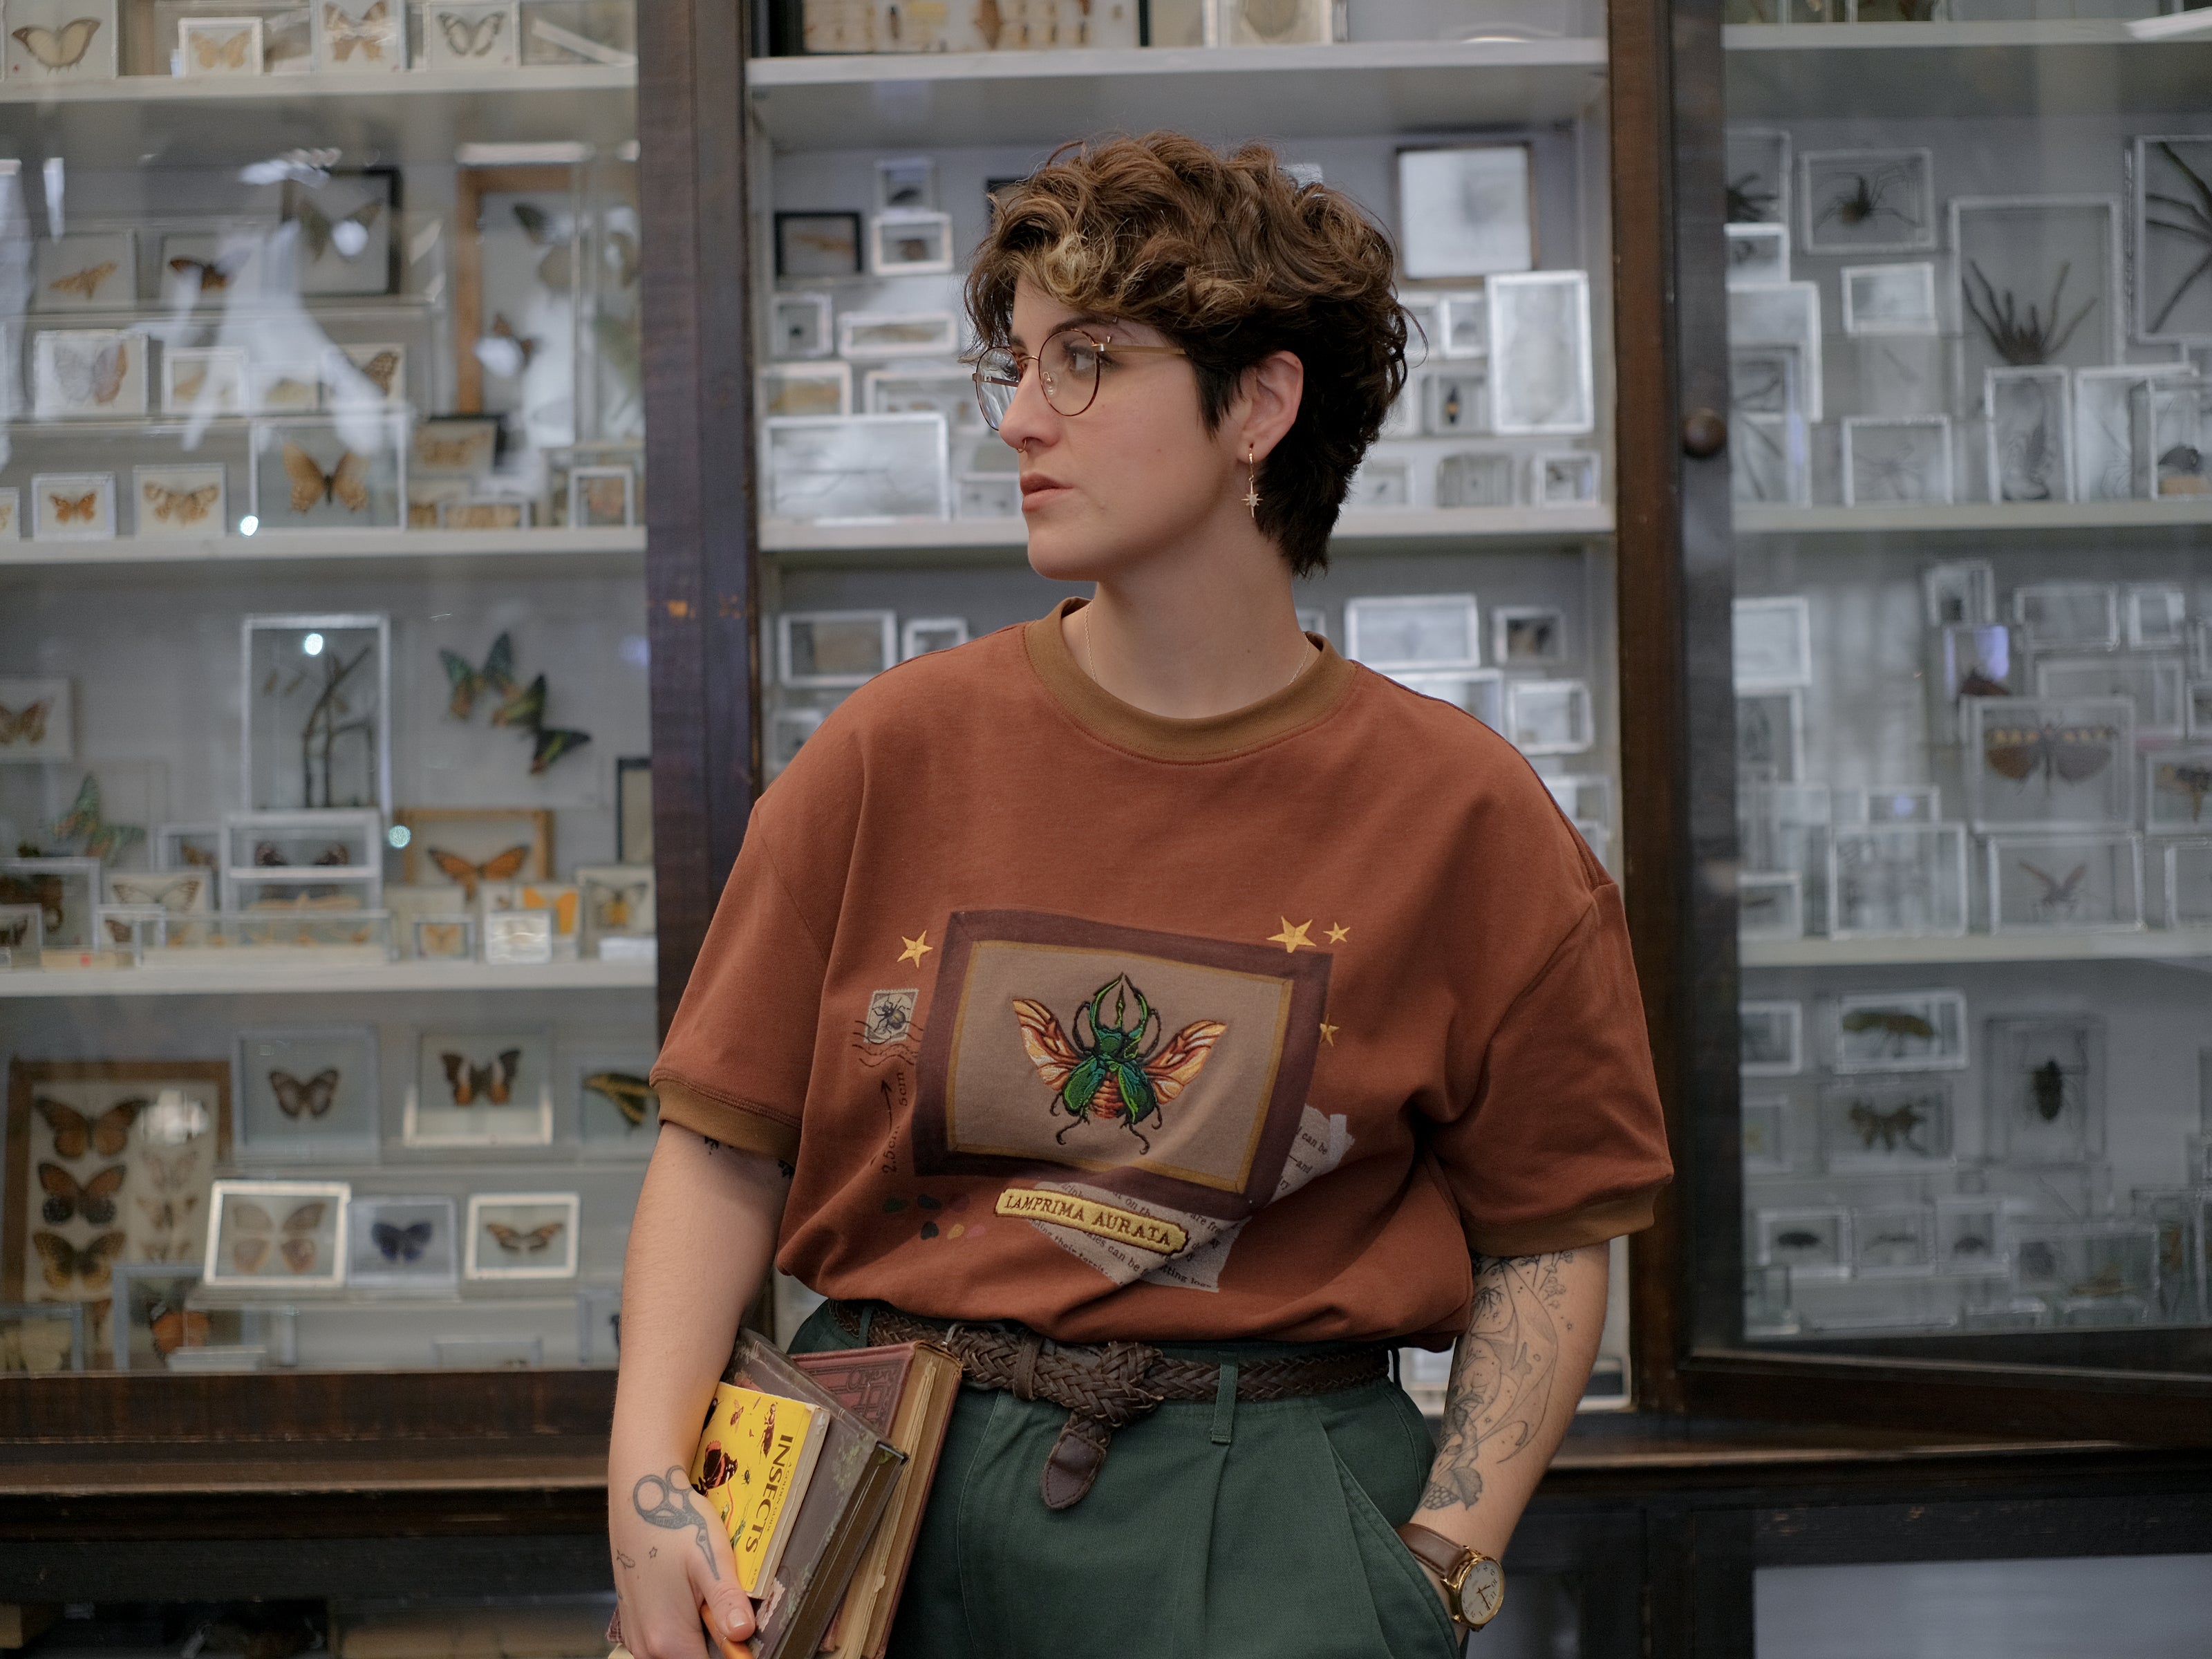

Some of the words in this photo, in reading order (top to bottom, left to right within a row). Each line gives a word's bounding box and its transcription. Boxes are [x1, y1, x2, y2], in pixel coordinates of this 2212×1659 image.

[1301, 1132, 1318, 1148] can
[1318, 1143, 1329, 1155] be
[1125, 1198, 1138, 1211] on
[1004, 1195, 1085, 1222] LAMPRIMA
[1091, 1211, 1171, 1247] AURATA
[1107, 1245, 1126, 1263] can
[1127, 1257, 1141, 1272] be
[746, 1434, 794, 1553] INSECTS
[776, 1470, 790, 1505] GOLDEN
[767, 1507, 779, 1532] GUIDE
[1490, 1578, 1498, 1588] 10
